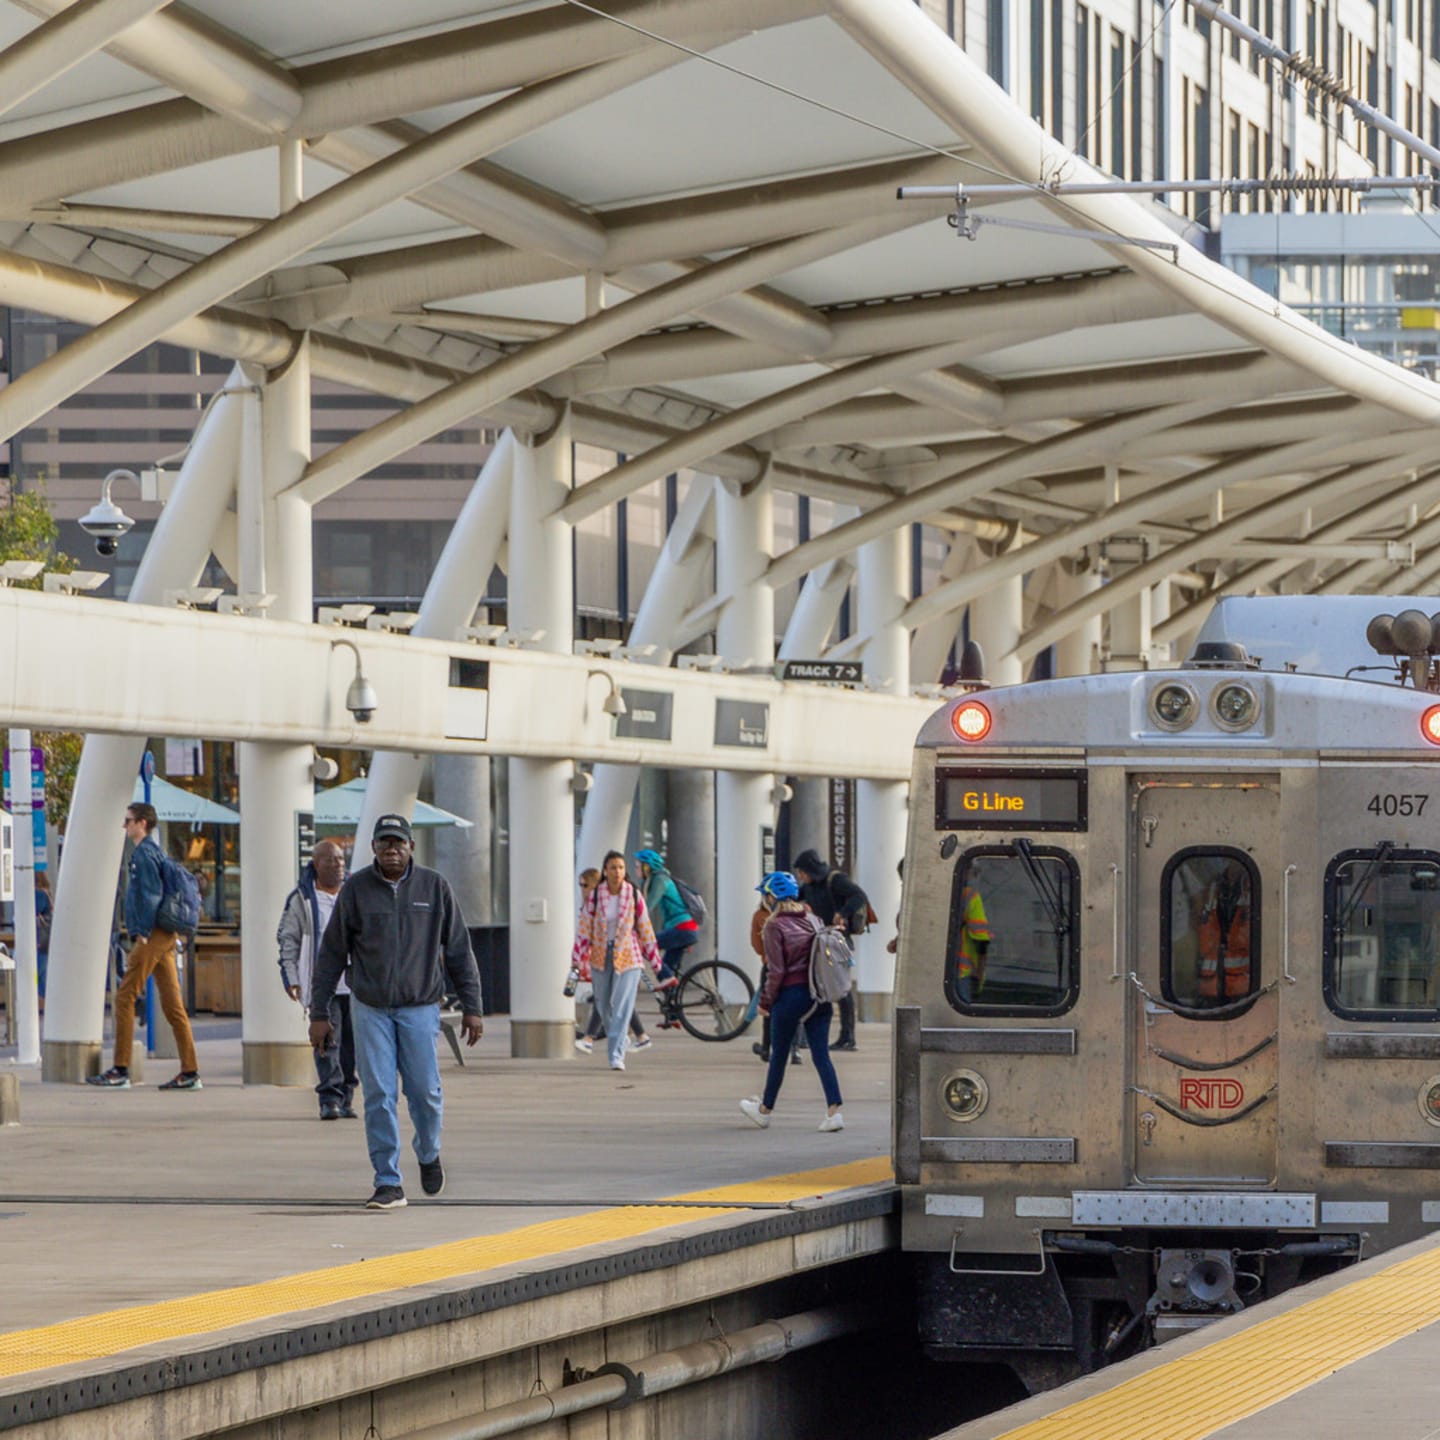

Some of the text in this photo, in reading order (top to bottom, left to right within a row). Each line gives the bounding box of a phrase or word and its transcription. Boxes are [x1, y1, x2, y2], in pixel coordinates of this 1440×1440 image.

[789, 665, 845, 678] TRACK 7
[963, 792, 1024, 811] G Line
[1367, 794, 1429, 817] 4057
[1179, 1077, 1244, 1110] RTD
